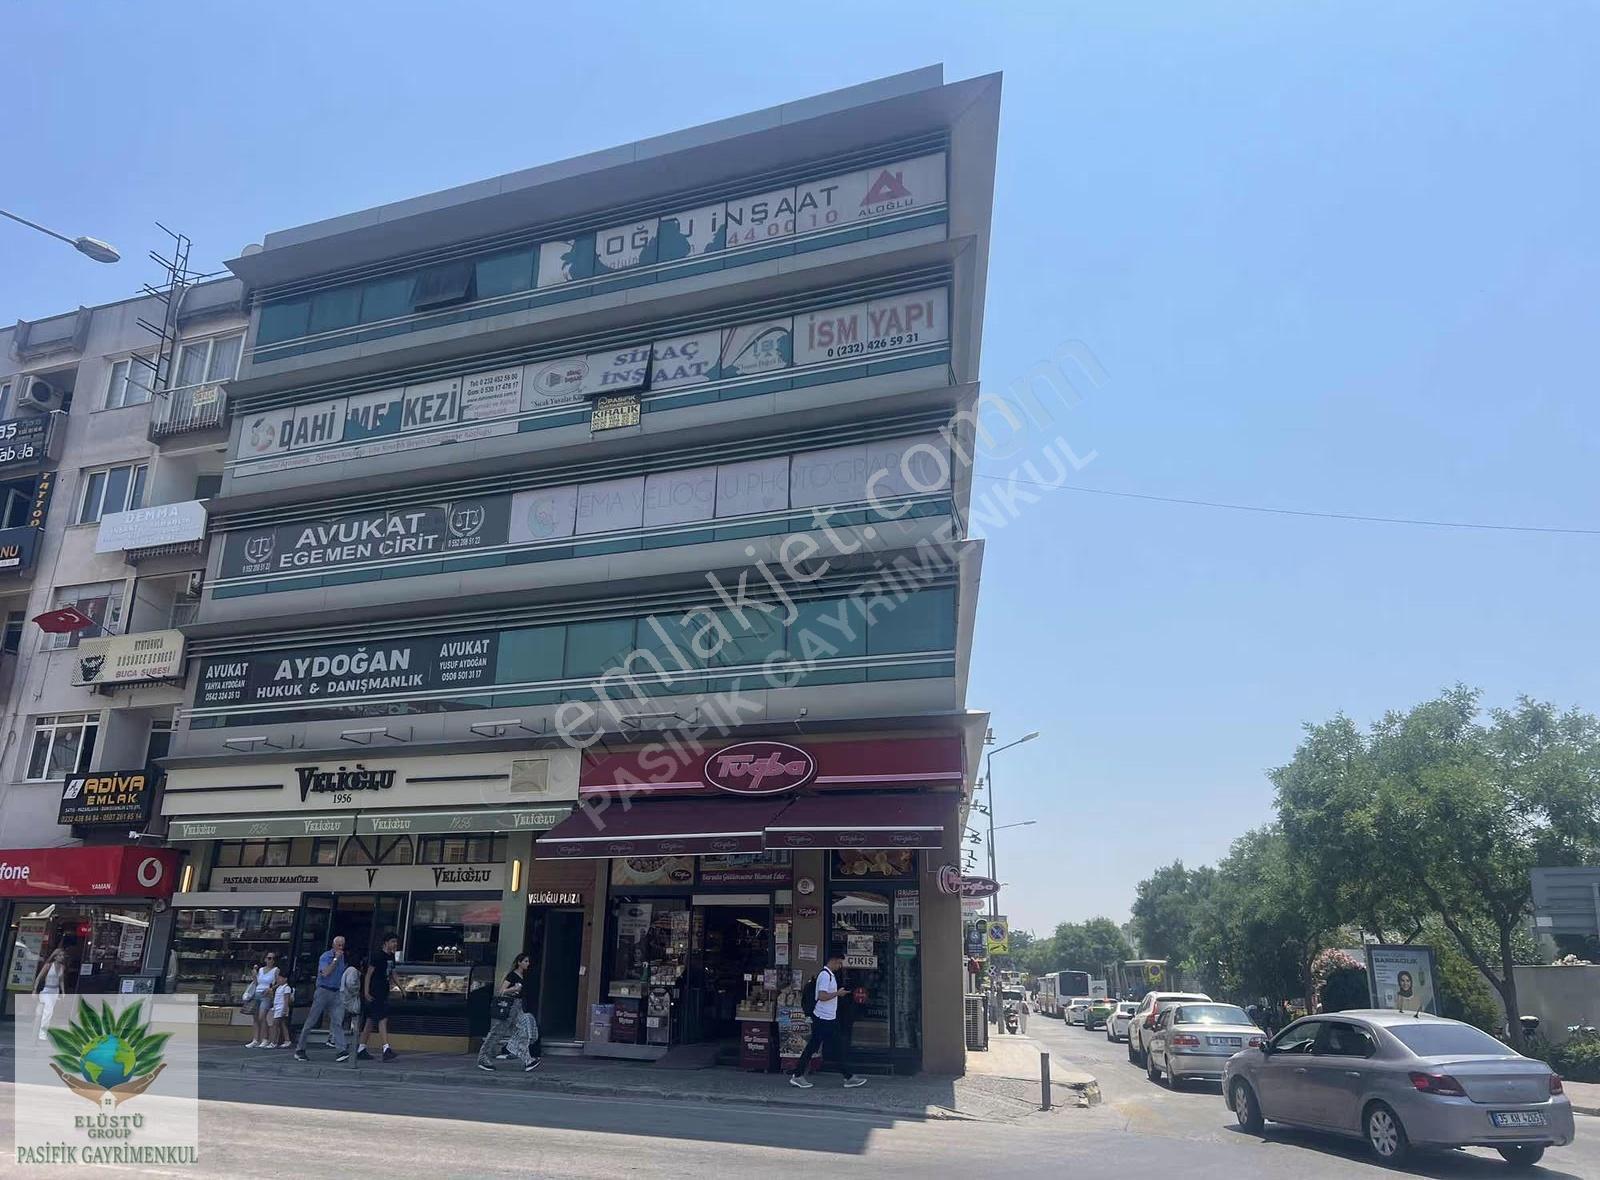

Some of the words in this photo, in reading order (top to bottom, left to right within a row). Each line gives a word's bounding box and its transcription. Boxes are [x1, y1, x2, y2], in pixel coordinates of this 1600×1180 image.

[808, 314, 858, 351] İSM
[869, 301, 934, 338] YAPI
[827, 348, 834, 357] 0
[837, 342, 864, 357] (232)
[867, 339, 887, 350] 426
[890, 336, 903, 345] 59
[905, 333, 919, 343] 31
[593, 405, 638, 418] KIRALIK
[278, 405, 336, 447] DAHİ
[30, 472, 51, 527] TATTOO
[295, 512, 426, 549] AVUKAT
[279, 542, 372, 568] EGEMEN
[439, 639, 490, 657] AVUKAT
[115, 669, 138, 678] BUCA
[206, 662, 249, 679] AVUKAT
[274, 648, 411, 681] AYDOĞAN
[439, 660, 459, 671] YUSUF
[459, 656, 487, 669] AYDOĞAN
[256, 683, 303, 698] HUKUK
[310, 682, 320, 695] &
[327, 674, 424, 694] DANIŞMANLIK
[83, 772, 145, 794] ADİVA
[87, 793, 137, 805] EMLAK
[332, 793, 352, 804] 1956
[223, 876, 251, 884] PASTANE
[366, 868, 379, 888] V
[559, 892, 580, 904] PLAZA
